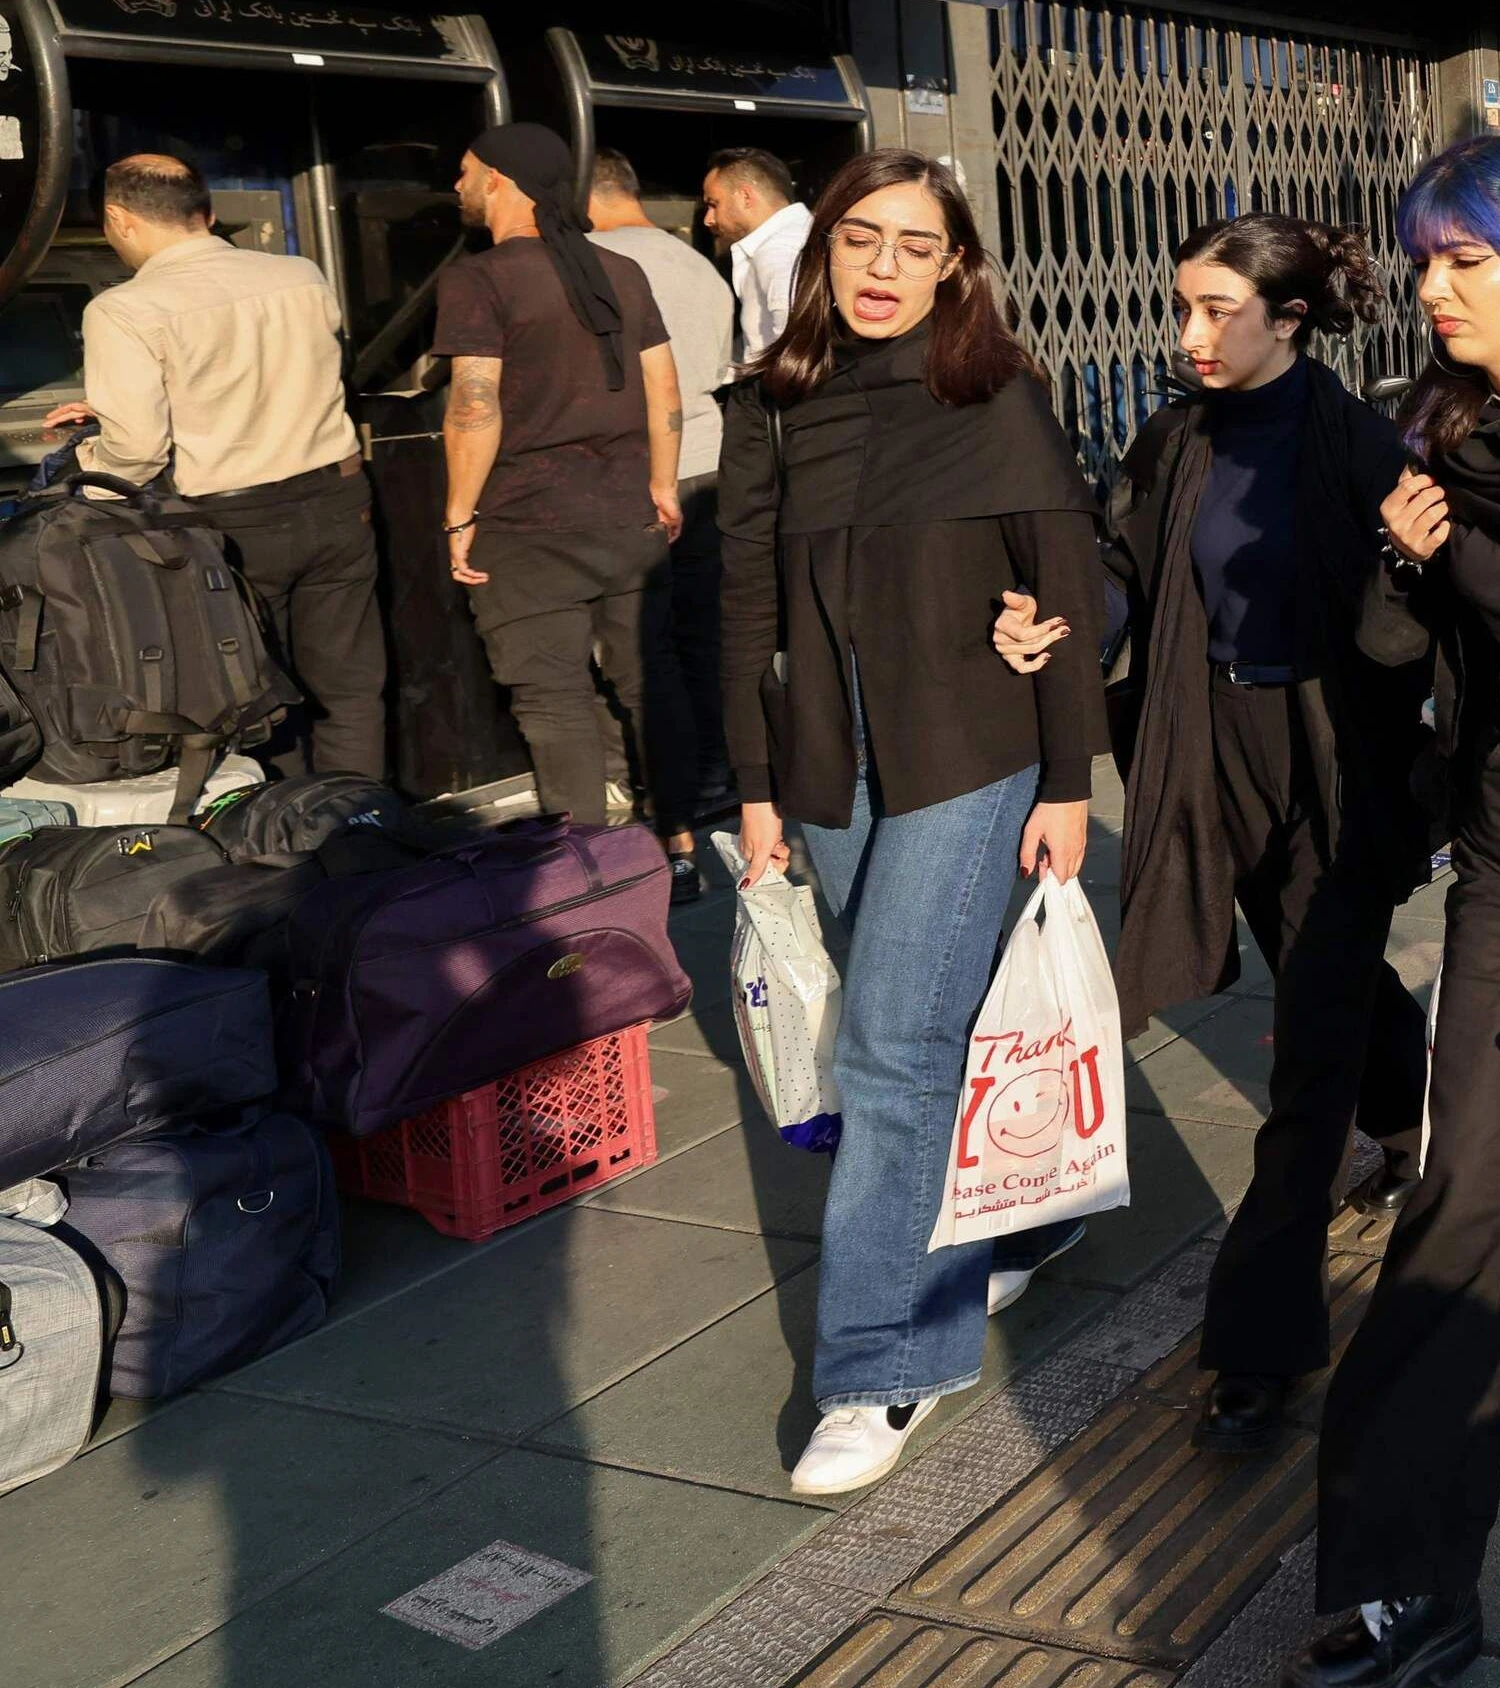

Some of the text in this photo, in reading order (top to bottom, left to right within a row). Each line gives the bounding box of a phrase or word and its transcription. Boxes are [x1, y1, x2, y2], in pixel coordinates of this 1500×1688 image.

[239, 2, 283, 25] بانک
[289, 10, 344, 29] نخستین
[348, 16, 378, 36] سپه
[382, 15, 423, 37] بانک
[974, 1016, 1077, 1073] Thank
[1002, 1166, 1058, 1190] Come
[1065, 1143, 1116, 1175] Again
[1020, 1188, 1051, 1206] شما
[1054, 1178, 1088, 1195] خرید
[954, 1198, 1017, 1220] متشکریم
